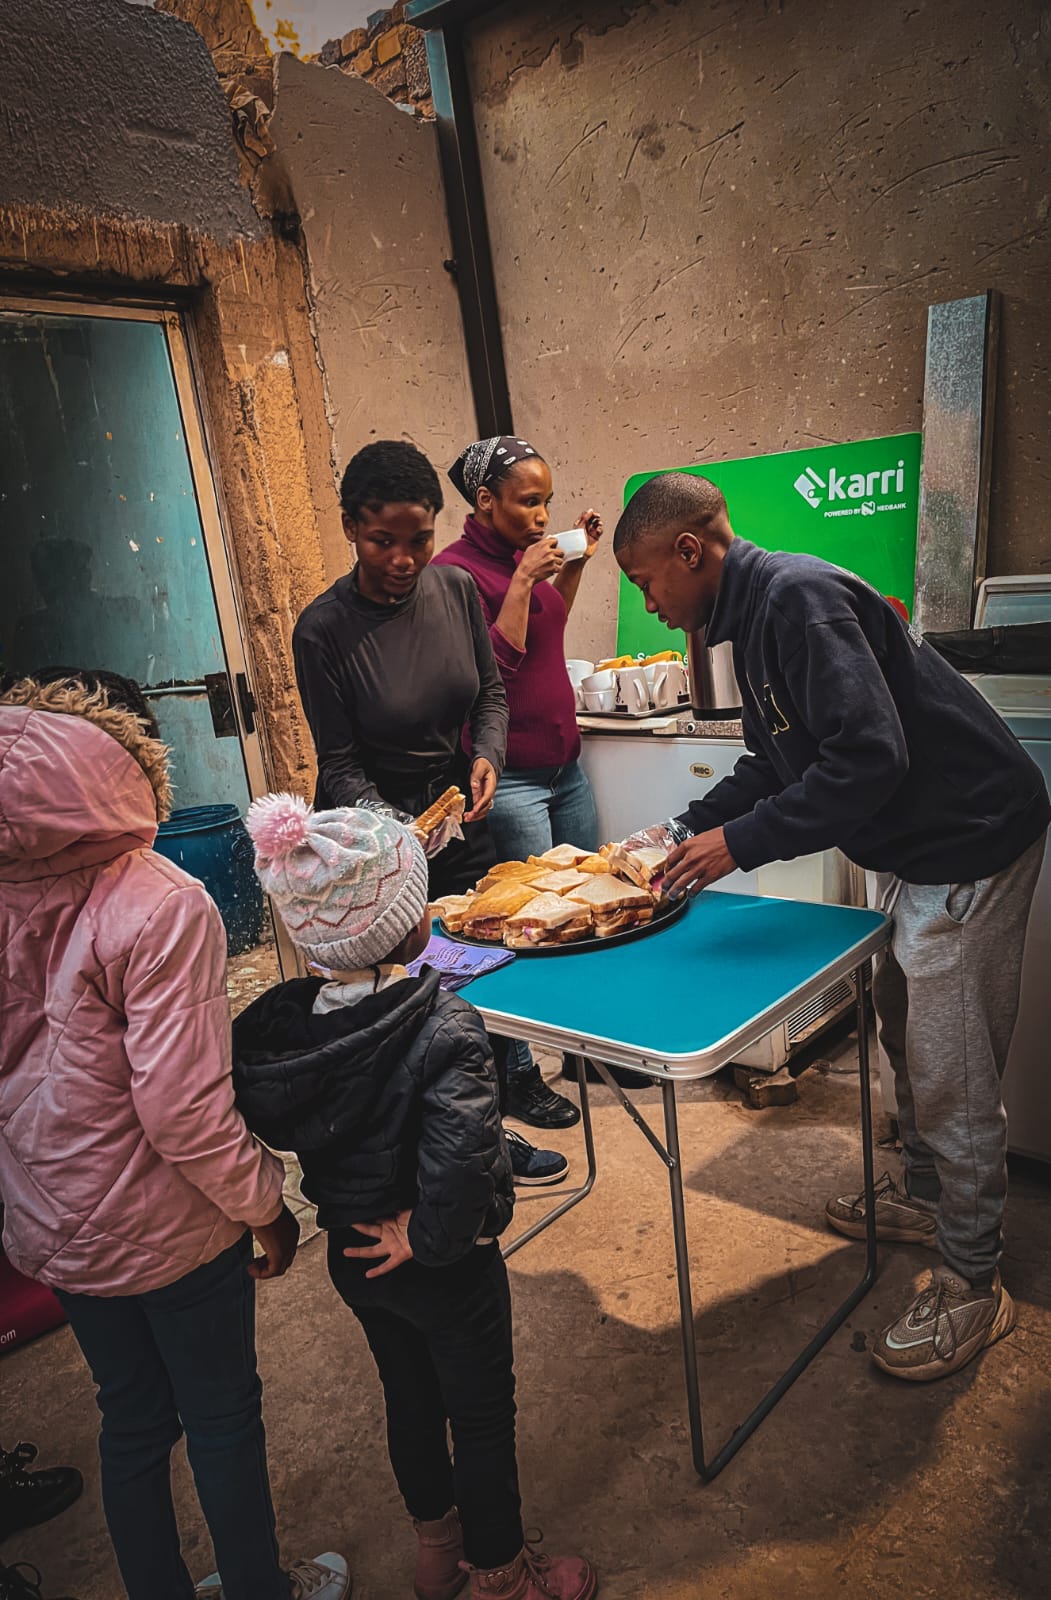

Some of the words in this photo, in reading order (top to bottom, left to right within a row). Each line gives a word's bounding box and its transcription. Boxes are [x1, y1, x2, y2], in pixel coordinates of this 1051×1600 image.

[828, 460, 904, 501] karri
[824, 509, 853, 518] POWERED
[876, 502, 907, 511] NEDBANK
